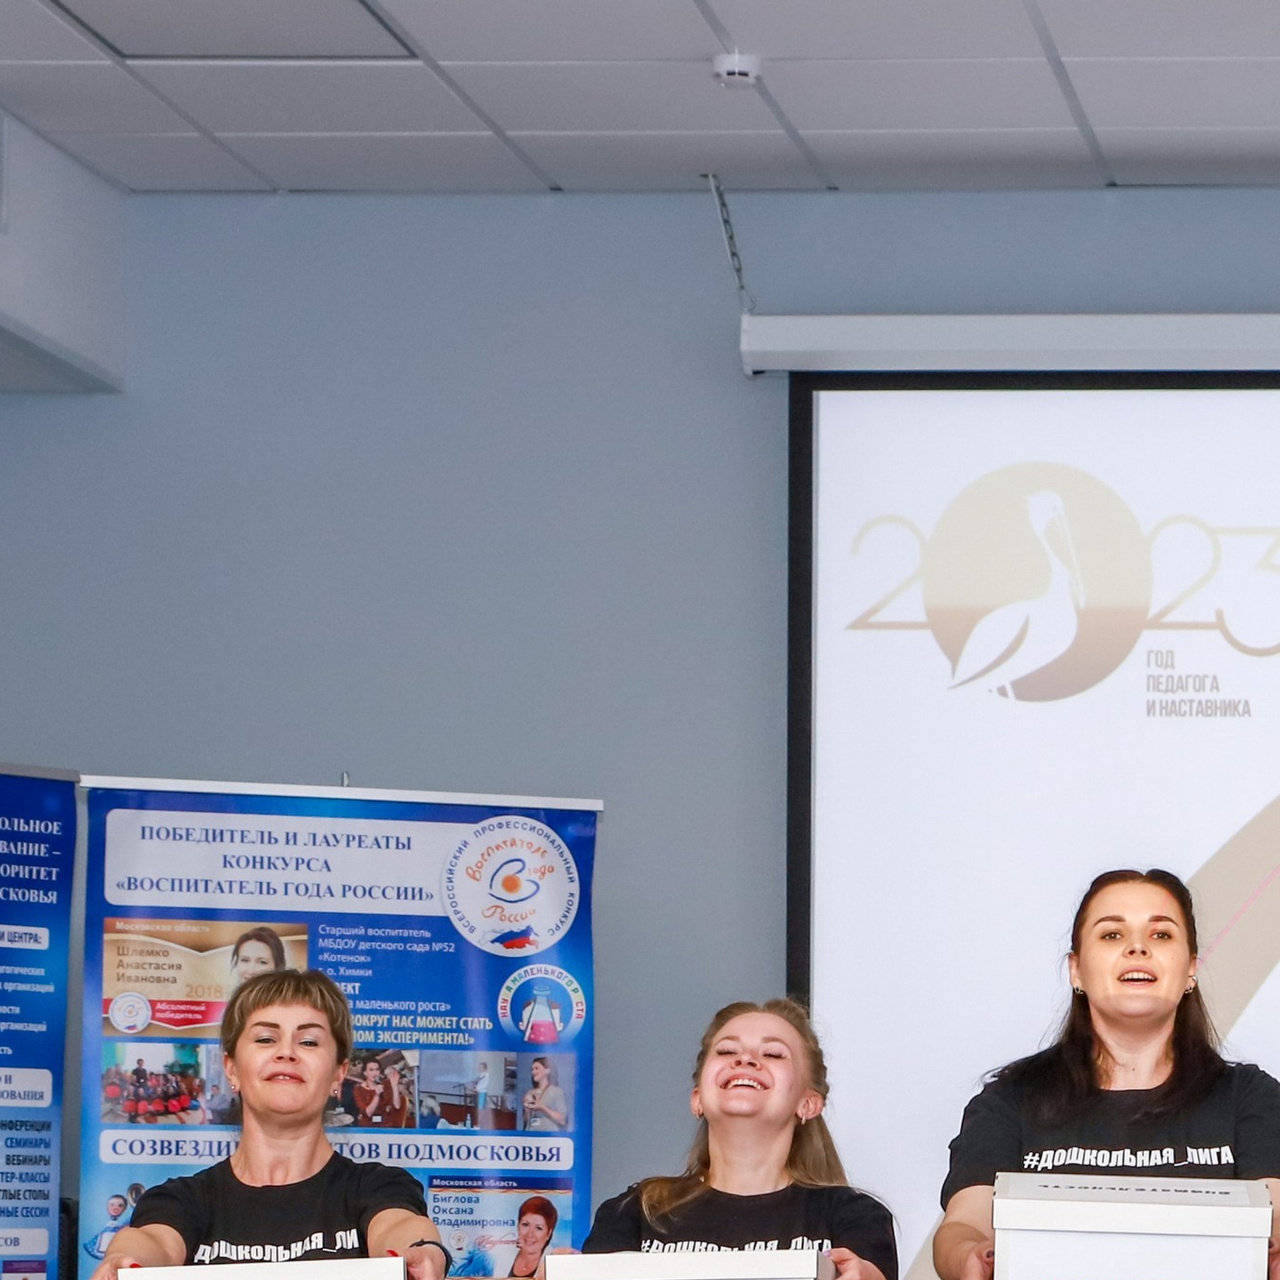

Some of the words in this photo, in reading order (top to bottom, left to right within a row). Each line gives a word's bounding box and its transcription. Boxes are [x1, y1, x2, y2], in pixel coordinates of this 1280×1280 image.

[1146, 649, 1176, 670] ГОД
[1146, 674, 1220, 693] ПЕДАГОГА
[1146, 699, 1157, 718] И
[1159, 699, 1252, 718] НАСТАВНИКА
[140, 825, 278, 845] ПОБЕДИТЕЛЬ
[284, 831, 299, 846] И
[303, 831, 412, 850] ЛАУРЕАТЫ
[222, 854, 332, 873] КОНКУРСА
[0, 863, 60, 881] ОРИТЕТ
[446, 839, 476, 934] ВСЕРОССИЙСКИЙ
[473, 820, 577, 884] ПРОФЕССИОНАЛЬНЫЙ
[547, 892, 576, 937] КОНКУРС
[0, 886, 58, 904] СКОВЬЯ
[116, 876, 277, 896] «ВОСПИТАТЕЛЬ
[283, 881, 334, 899] ГОДА
[341, 884, 434, 901] РОССИИ»
[7, 932, 42, 944] ЦЕНТРА:
[318, 924, 366, 936] Старший
[367, 928, 432, 938] воспитатель
[116, 946, 170, 959] Шлемко
[318, 938, 357, 950] МБДОУ
[358, 940, 404, 951] детского
[405, 943, 430, 952] сада
[431, 942, 456, 953] №52
[318, 953, 372, 963] «Котенок»
[116, 959, 182, 972] Анастасия
[338, 967, 373, 977] Химки
[116, 972, 178, 984] Ивановна
[185, 983, 224, 998] 2018
[355, 1000, 416, 1011] маленького
[417, 1001, 451, 1013] роста»
[392, 1015, 414, 1028] НАС
[416, 1016, 458, 1029] МОЖЕТ
[459, 1017, 494, 1030] СТАТЬ
[377, 1031, 475, 1045] ЭКСПЕРИМЕНТА!»
[5, 1137, 51, 1149] СЕМИНАРЫ
[111, 1138, 240, 1160] СОЗВЕЗДИ
[387, 1143, 562, 1164] ПОДМОСКОВЬЯ
[1023, 1145, 1235, 1171] #ДОШКОЛЬНАЯ_ЛИГА
[5, 1154, 51, 1166] ВЕБИНАРЫ
[432, 1179, 483, 1187] Московская
[484, 1179, 518, 1188] область
[23, 1189, 50, 1201] СТОЛЫ
[432, 1194, 480, 1204] Биглова
[20, 1206, 49, 1217] СЕССИИ
[432, 1205, 474, 1215] Оксана
[433, 1217, 516, 1229] Владимировна
